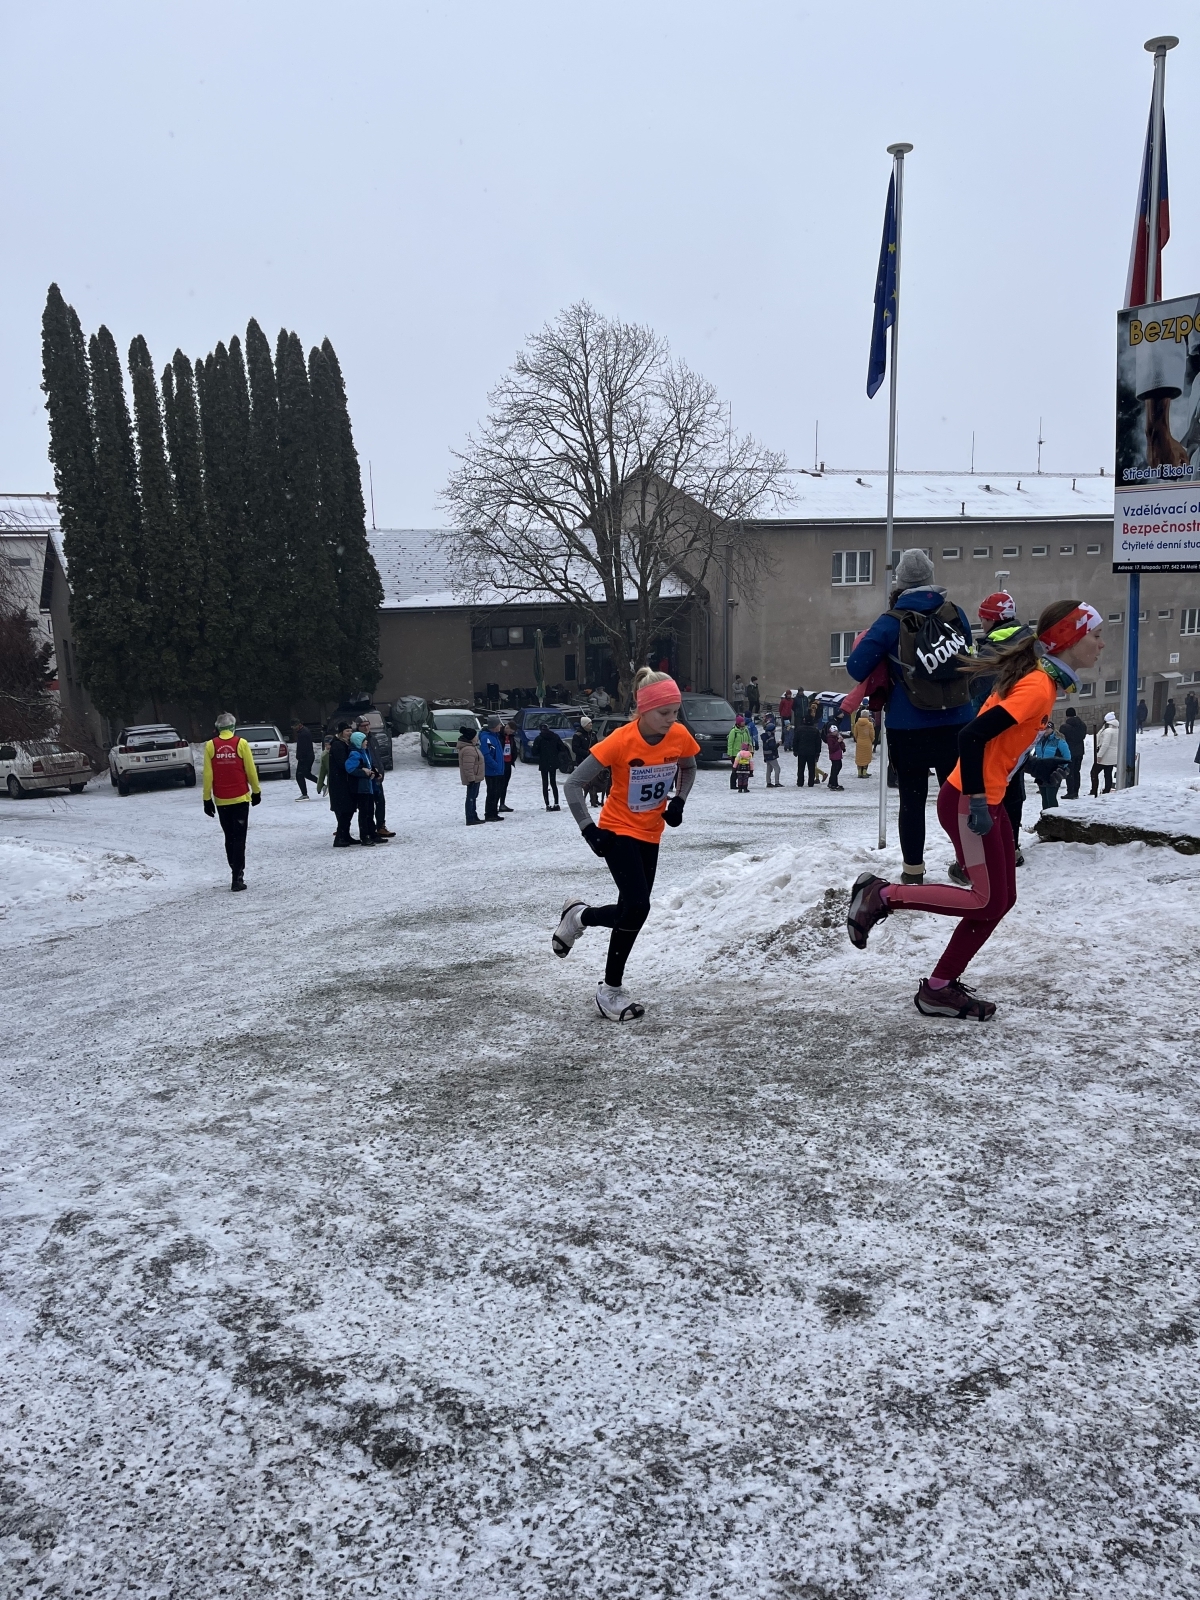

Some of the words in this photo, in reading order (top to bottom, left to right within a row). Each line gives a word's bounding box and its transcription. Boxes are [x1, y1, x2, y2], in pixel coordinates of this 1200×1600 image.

[1123, 464, 1163, 481] Střední
[1163, 463, 1194, 477] škola
[1123, 501, 1187, 517] Vzdělávací
[1190, 502, 1200, 513] o
[1121, 540, 1154, 551] Čtyřleté
[1156, 539, 1182, 549] denní
[632, 767, 653, 775] ZIMNÍ
[640, 782, 666, 802] 58
